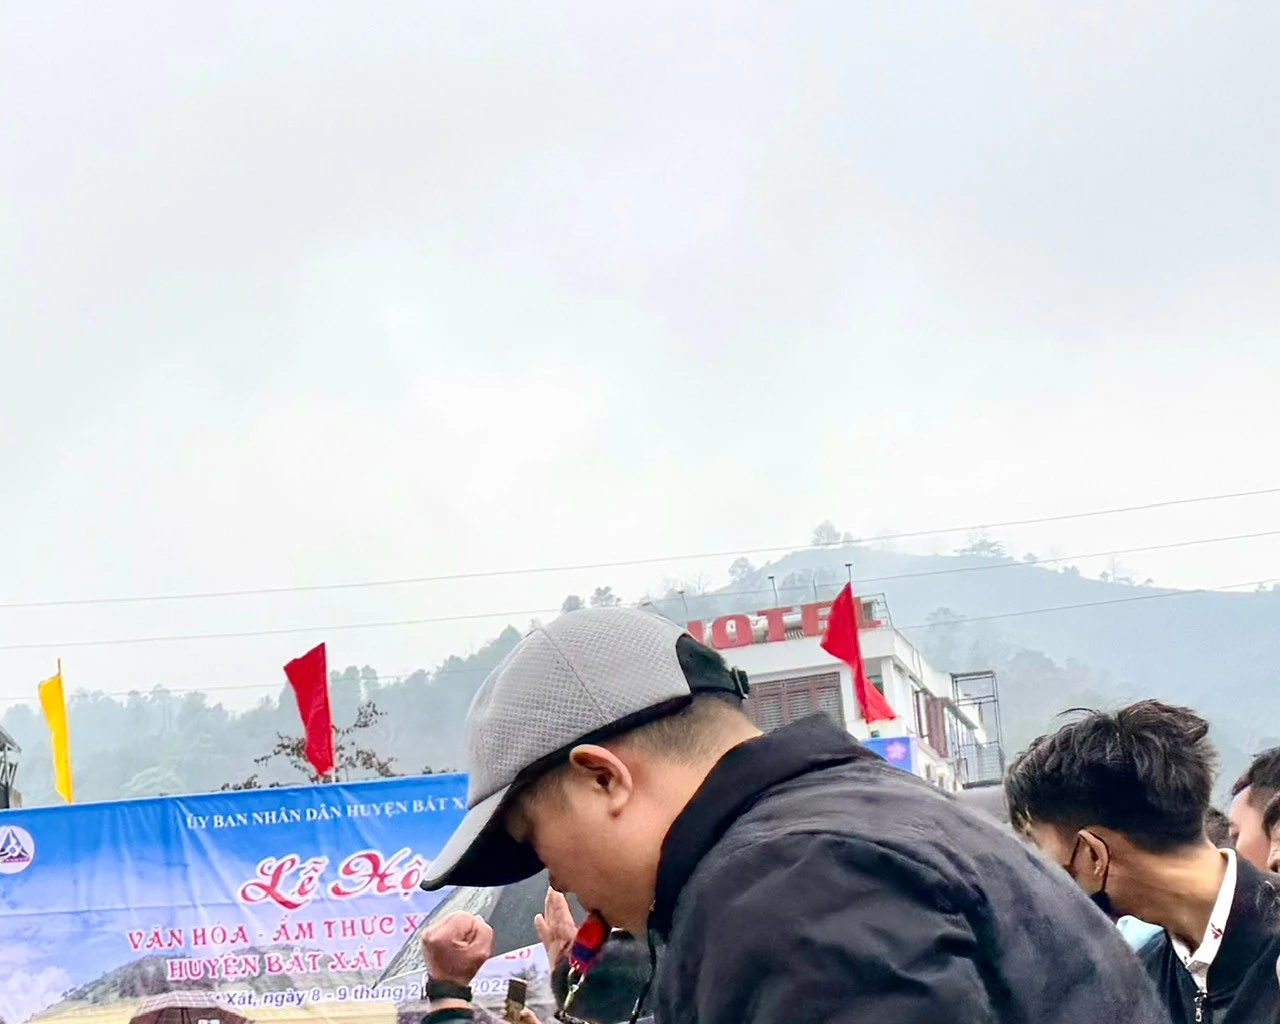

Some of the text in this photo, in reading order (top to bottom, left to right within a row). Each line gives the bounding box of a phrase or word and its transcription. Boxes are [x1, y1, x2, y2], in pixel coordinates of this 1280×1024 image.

[213, 813, 248, 829] BAN
[252, 808, 302, 825] NHÂN
[305, 803, 342, 821] DÂN
[412, 795, 449, 813] BÁT
[239, 855, 326, 910] Lễ
[126, 924, 183, 950] VĂN
[322, 914, 395, 941] THỰC
[167, 951, 260, 982] HUYỆN
[328, 944, 388, 970] XÁT
[226, 991, 257, 1007] Xát,
[263, 988, 306, 1007] ngày
[311, 988, 321, 1000] 8
[336, 986, 347, 1000] 9
[352, 982, 404, 1002] tháng
